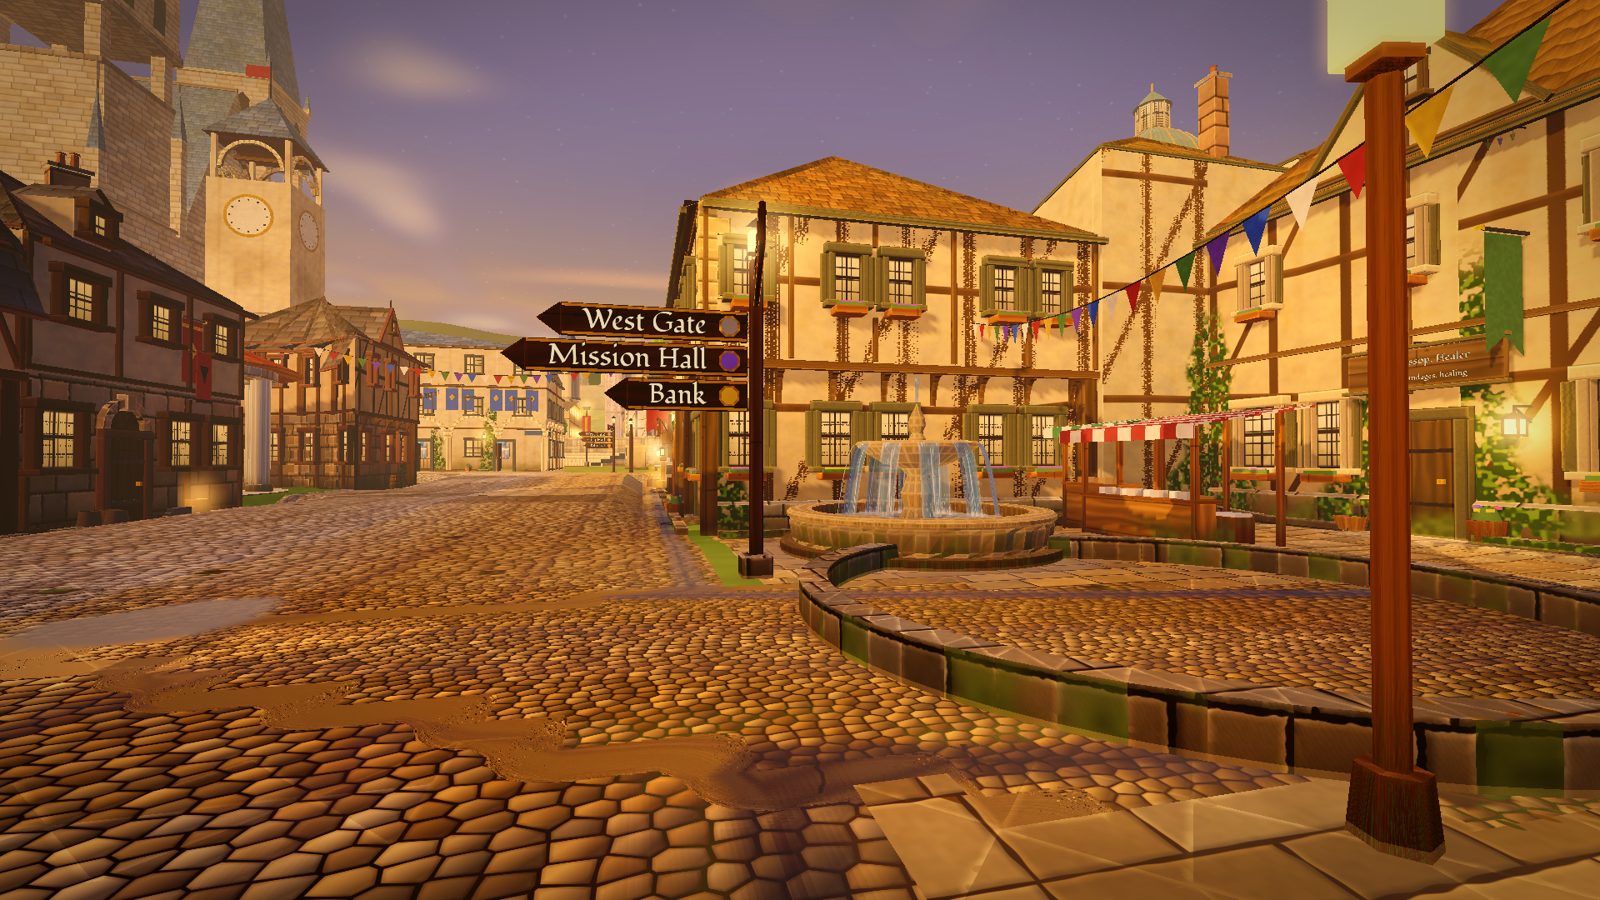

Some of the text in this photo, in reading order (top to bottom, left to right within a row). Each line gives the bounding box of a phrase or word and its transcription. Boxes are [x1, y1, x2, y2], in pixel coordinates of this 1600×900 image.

[582, 307, 706, 334] West Gate
[548, 341, 707, 369] Mission Hall
[1436, 350, 1471, 362] Healer
[1439, 369, 1468, 378] healing
[649, 381, 707, 405] Bank
